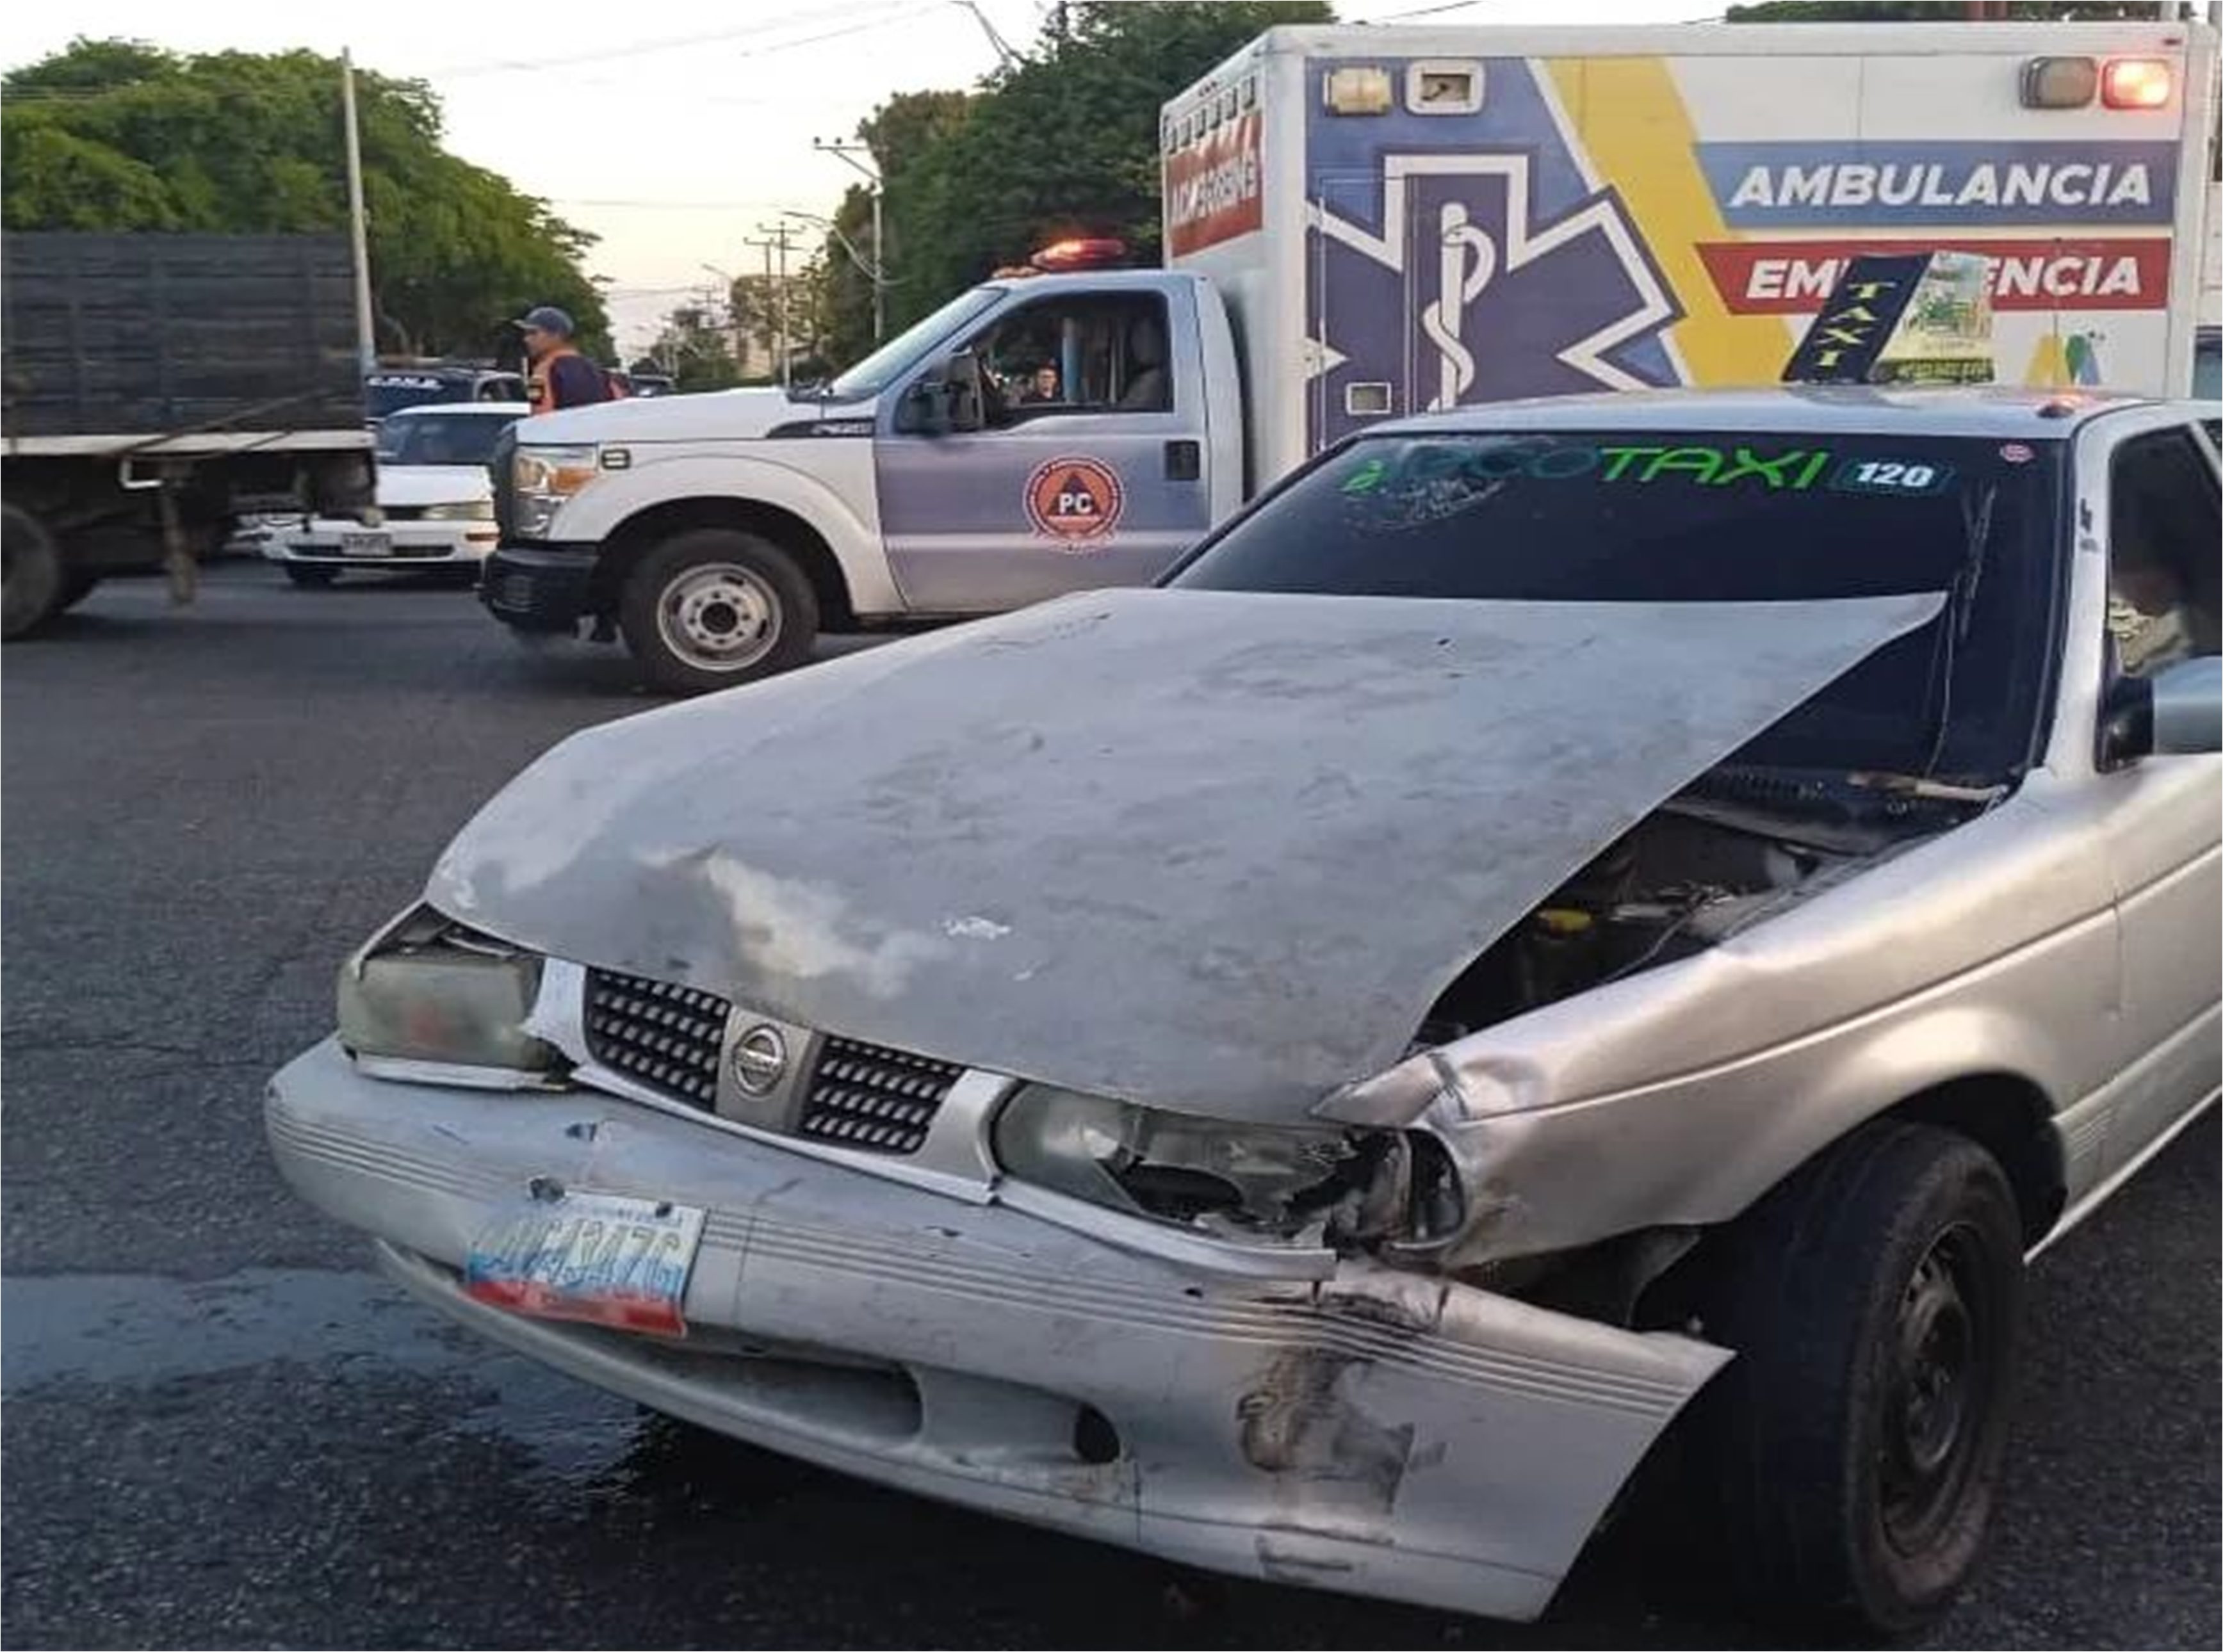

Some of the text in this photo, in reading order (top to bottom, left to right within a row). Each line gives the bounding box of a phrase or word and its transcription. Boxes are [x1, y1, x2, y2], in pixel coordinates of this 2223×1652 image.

[1731, 164, 2151, 206] AMBULANCIA
[1816, 279, 1898, 367] TAXI
[1857, 462, 1934, 488] 120
[1059, 492, 1093, 515] PC
